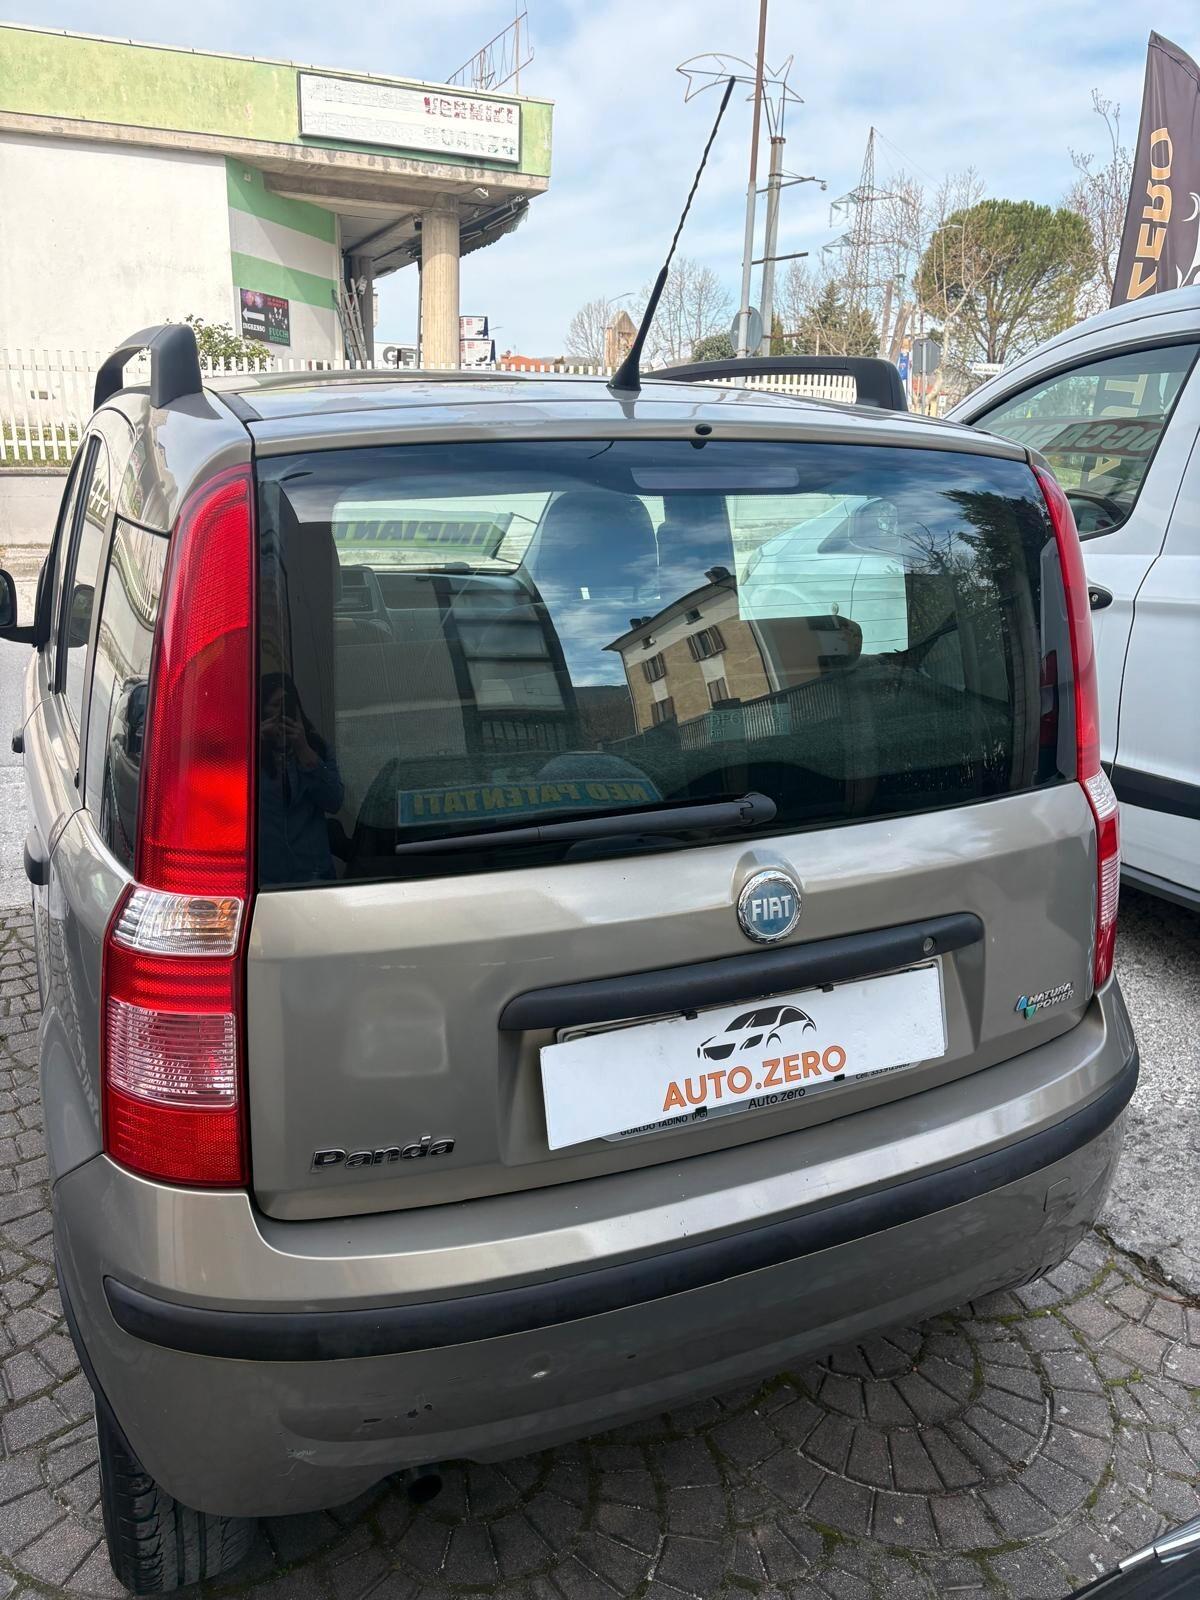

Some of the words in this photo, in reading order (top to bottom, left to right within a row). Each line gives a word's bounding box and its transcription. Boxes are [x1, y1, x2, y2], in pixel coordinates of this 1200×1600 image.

[752, 895, 791, 922] FIAT
[1035, 990, 1074, 1011] POWER
[663, 1045, 847, 1112] AUTO.ZERO
[748, 1088, 806, 1110] Auto.zero
[657, 1115, 688, 1128] TADINO
[310, 1134, 456, 1174] Panda
